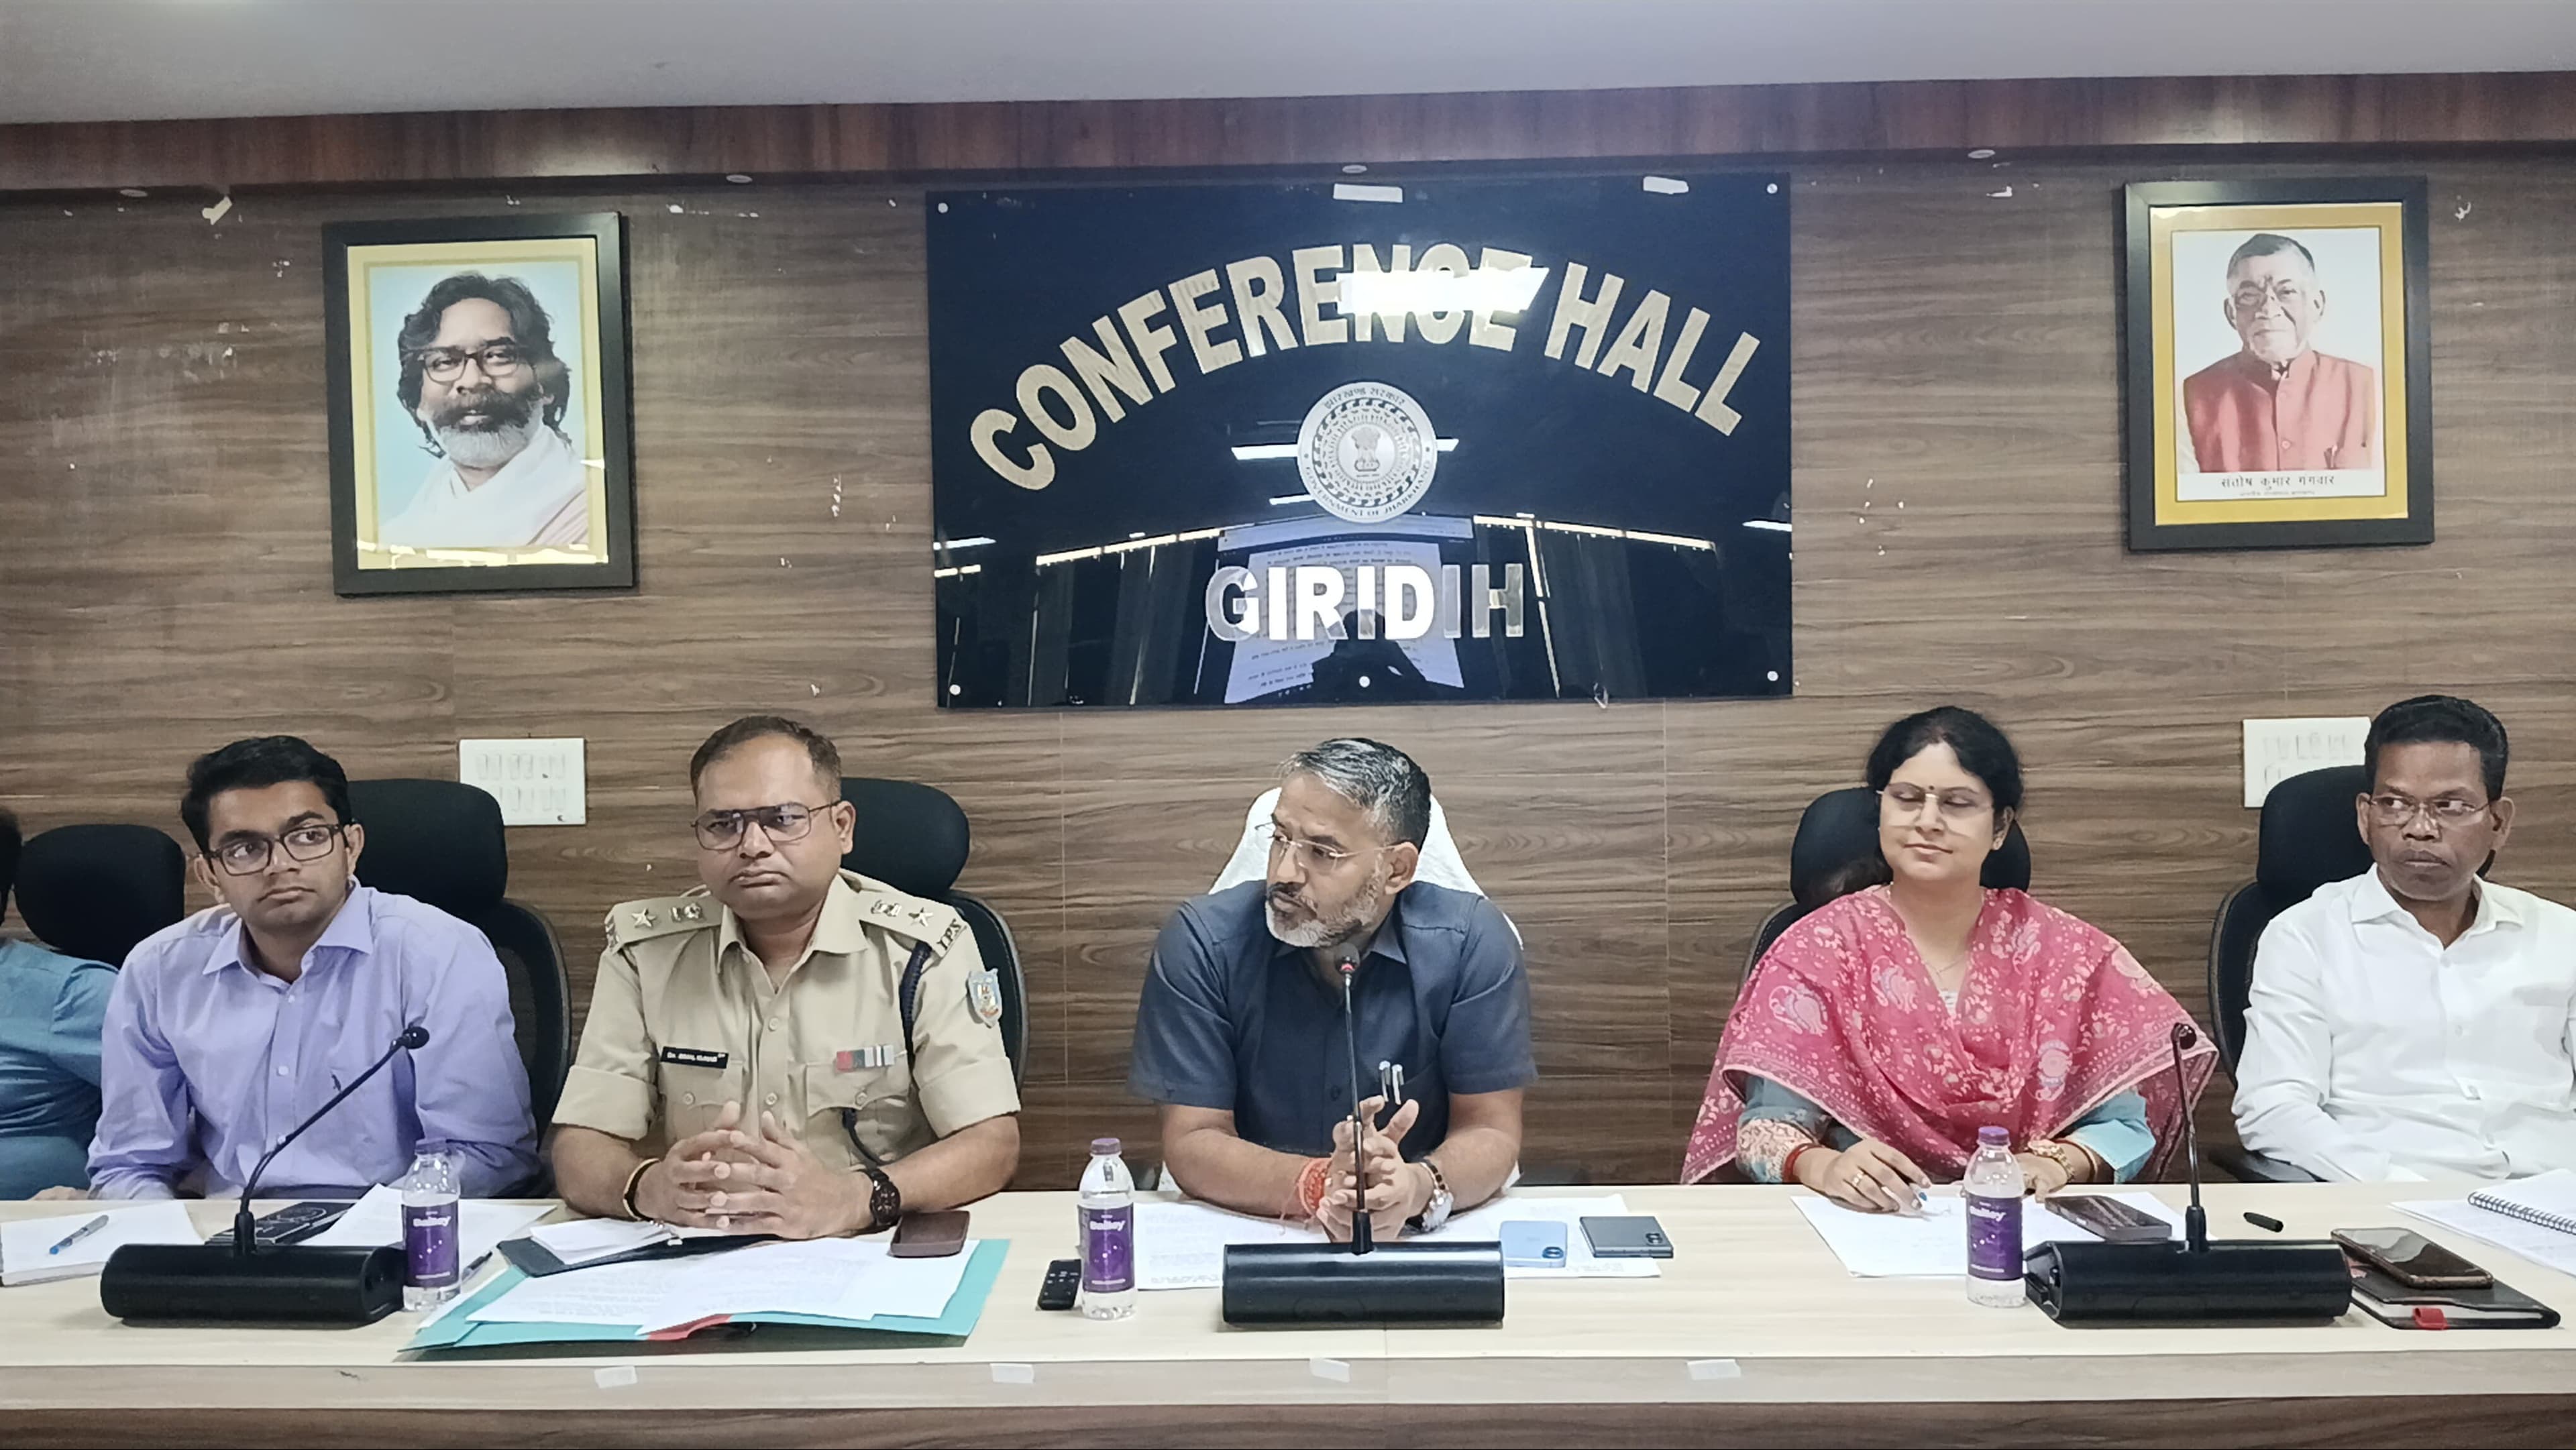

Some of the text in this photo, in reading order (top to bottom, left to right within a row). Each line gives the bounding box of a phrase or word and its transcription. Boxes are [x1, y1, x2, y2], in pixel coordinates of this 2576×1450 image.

[970, 243, 1760, 490] CONFERENCE HALL
[1205, 564, 1524, 642] GIRIDIH
[936, 918, 961, 951] IPS
